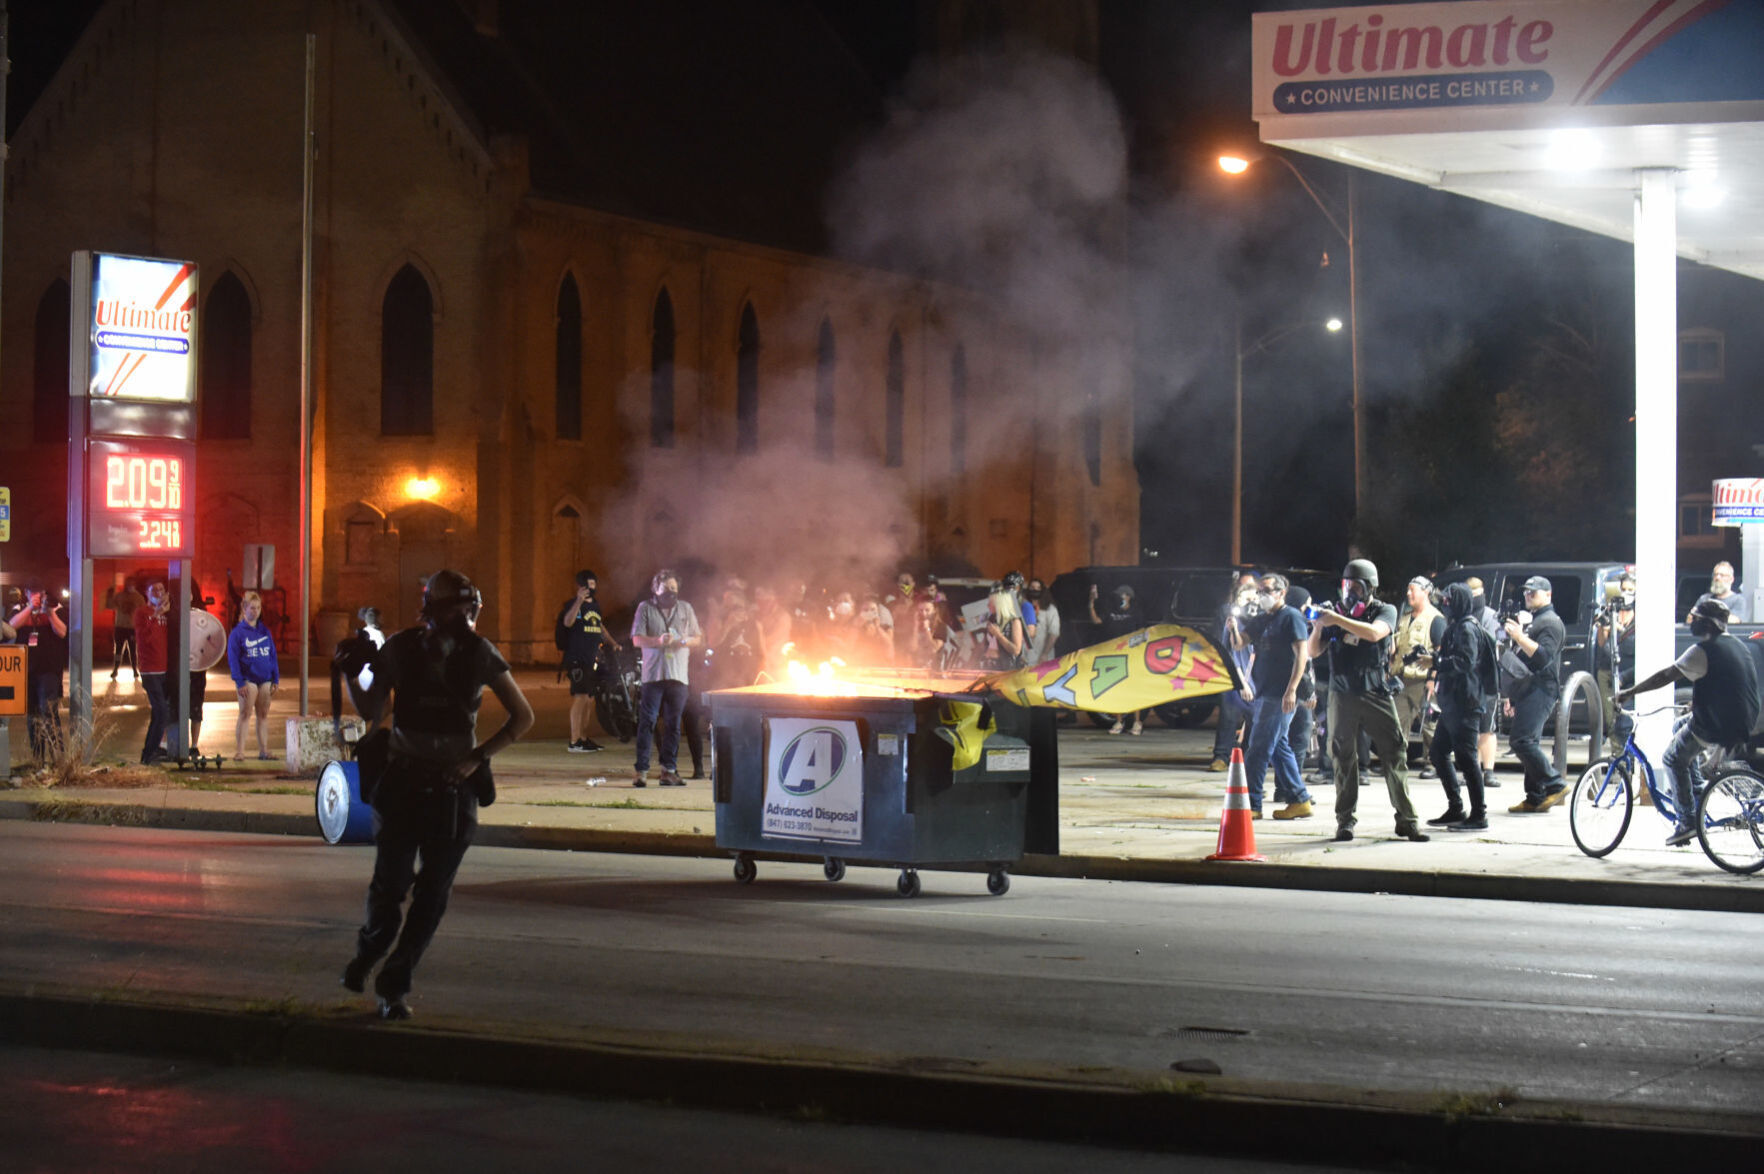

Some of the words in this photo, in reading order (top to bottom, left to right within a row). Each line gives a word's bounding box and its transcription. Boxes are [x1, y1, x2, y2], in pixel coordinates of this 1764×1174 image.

[1272, 14, 1554, 77] Ultimate
[1300, 82, 1441, 106] CONVENIENCE
[1447, 79, 1525, 99] CENTER
[96, 300, 192, 333] Ultimate
[767, 803, 813, 818] Advanced
[815, 807, 858, 823] Disposal
